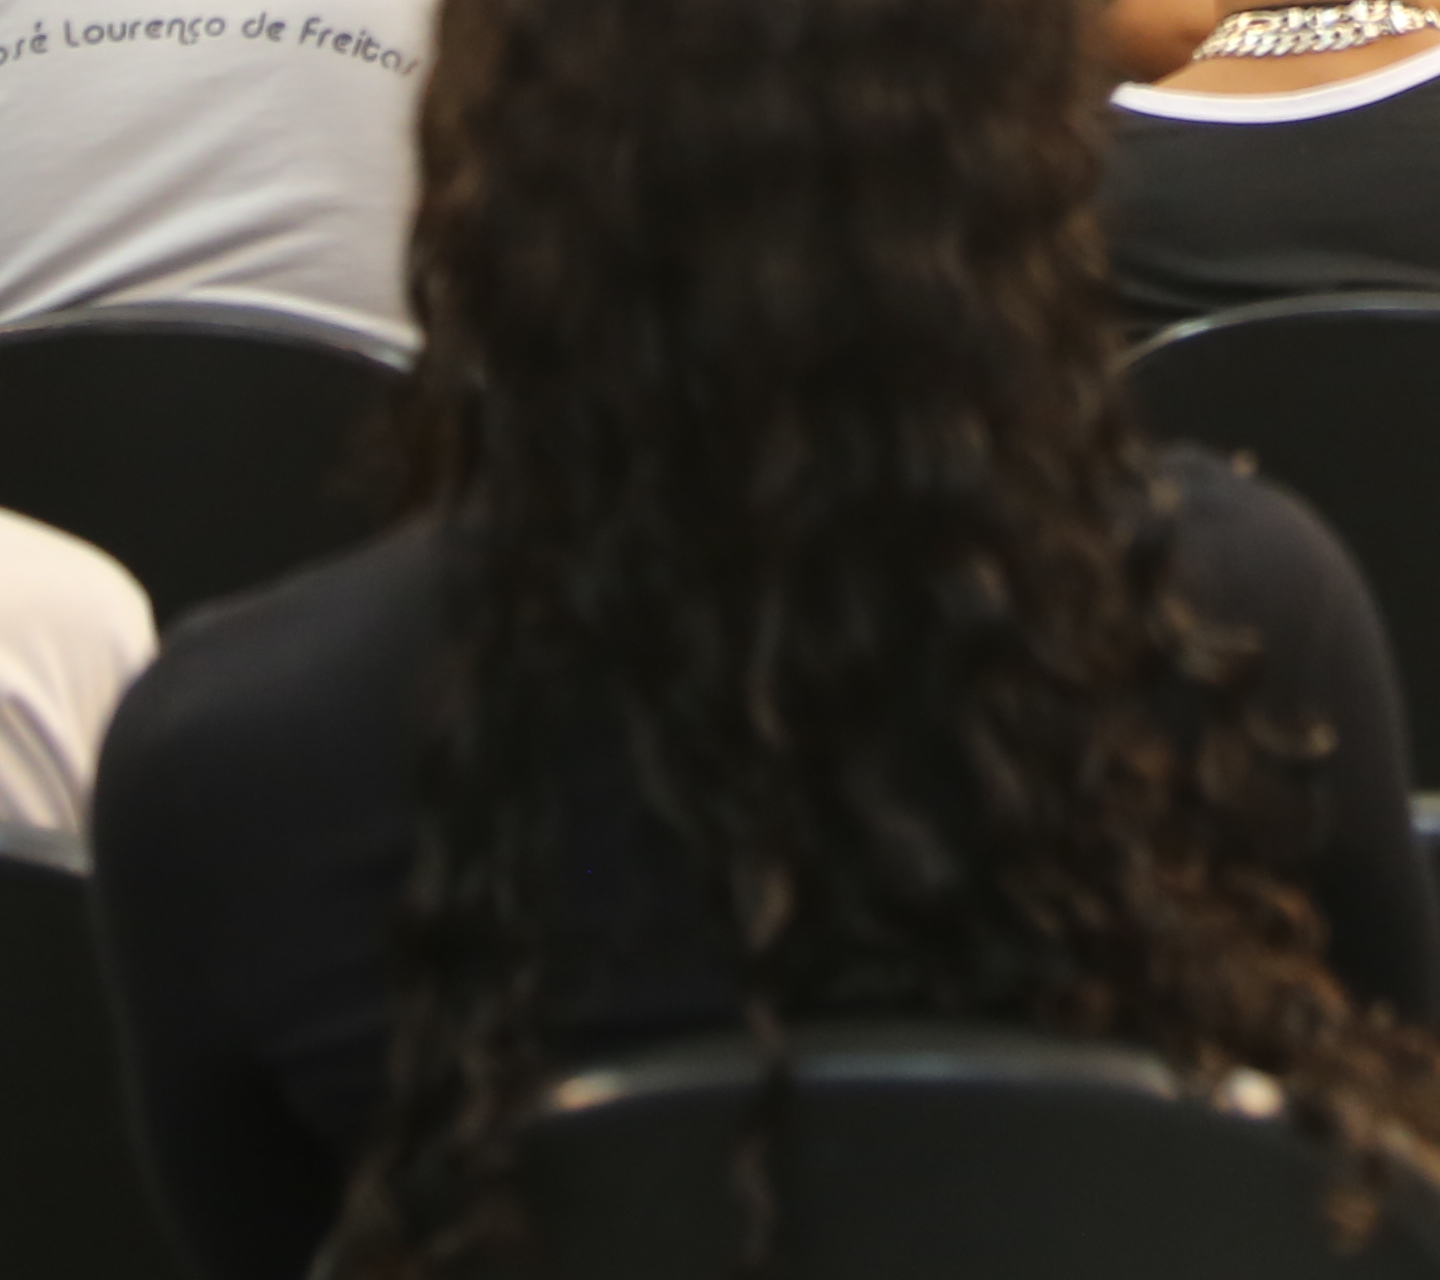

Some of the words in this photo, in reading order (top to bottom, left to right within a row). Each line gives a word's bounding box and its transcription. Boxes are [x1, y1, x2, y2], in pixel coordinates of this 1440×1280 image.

[64, 15, 227, 48] Lourenço
[242, 12, 286, 41] de
[299, 17, 419, 75] Freitas
